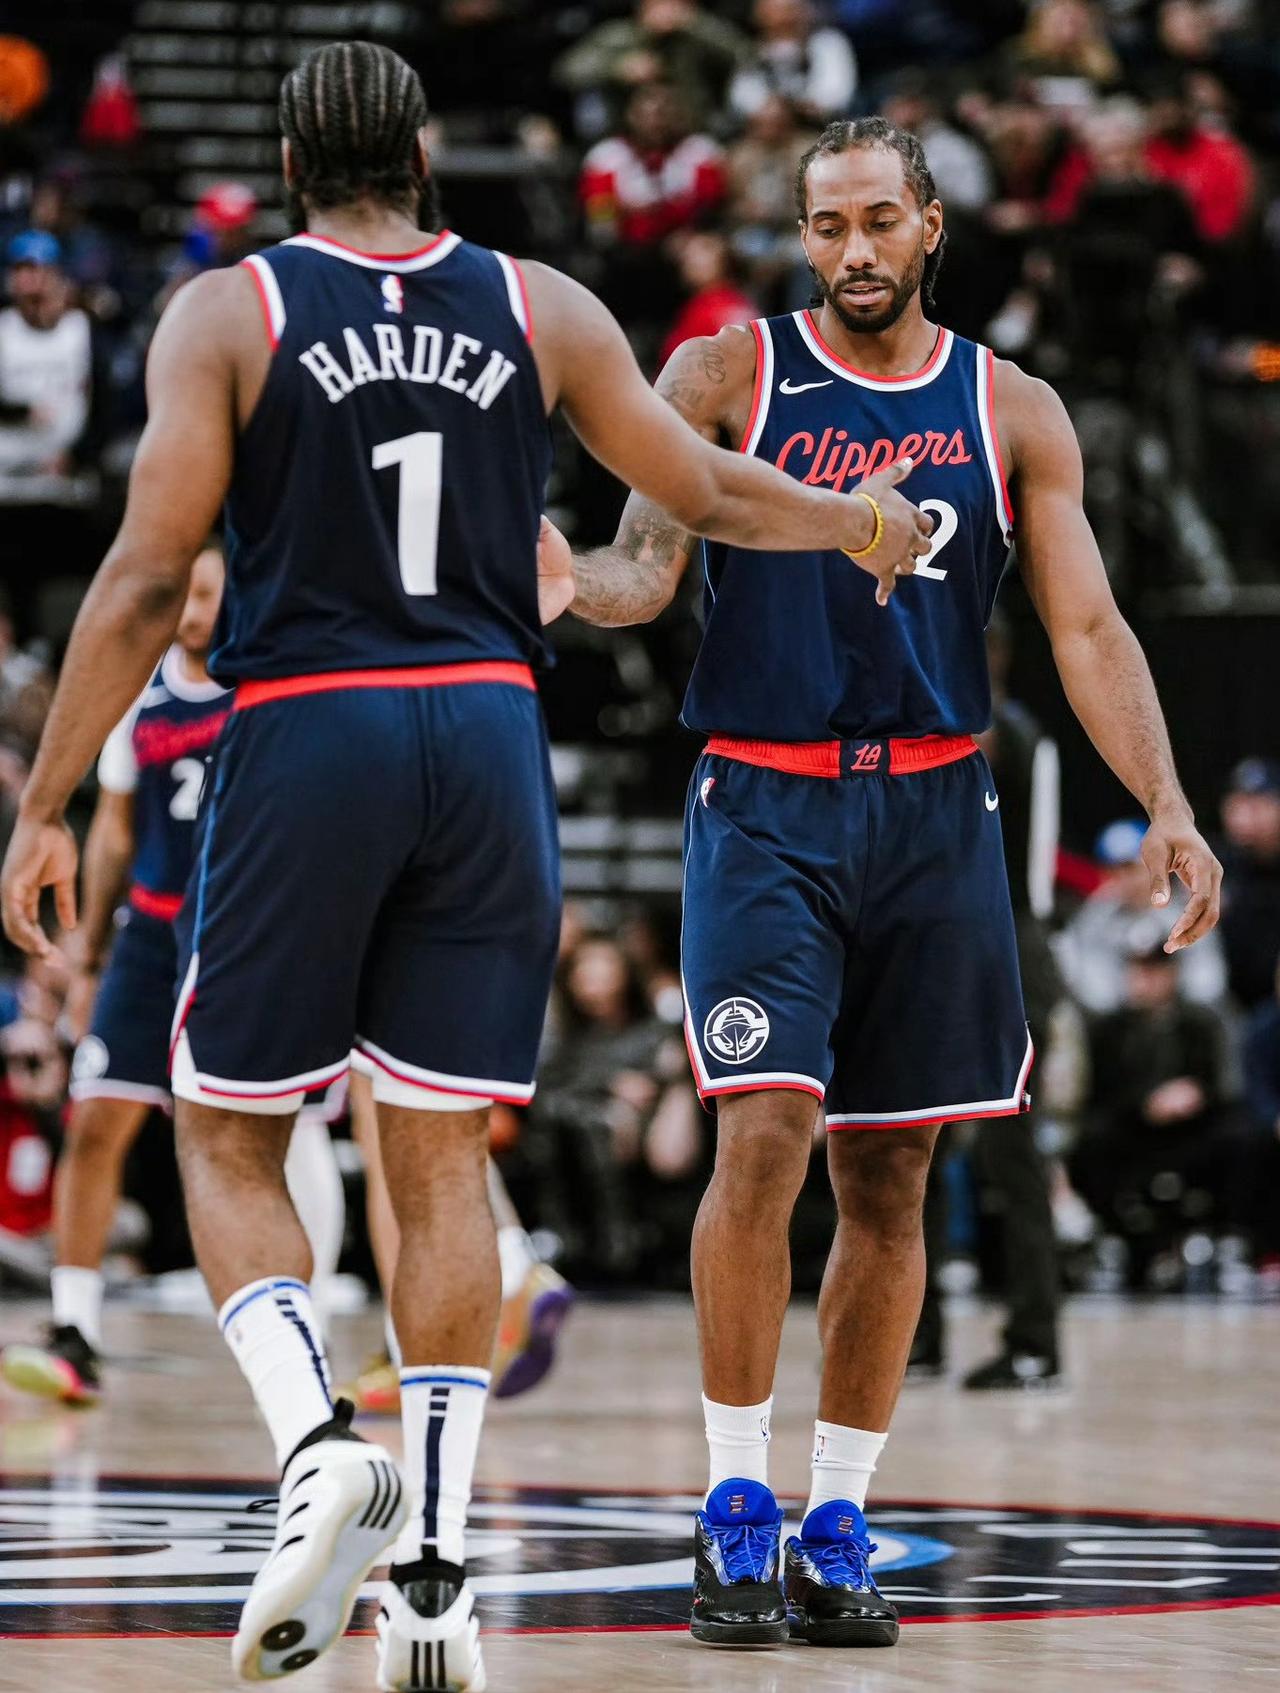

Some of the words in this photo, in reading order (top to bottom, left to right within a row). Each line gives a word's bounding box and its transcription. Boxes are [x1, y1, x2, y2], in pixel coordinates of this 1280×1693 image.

[298, 323, 518, 411] HARDEN
[775, 426, 973, 494] Clippers
[371, 431, 444, 596] 1
[912, 498, 959, 582] 2
[850, 743, 883, 771] LA
